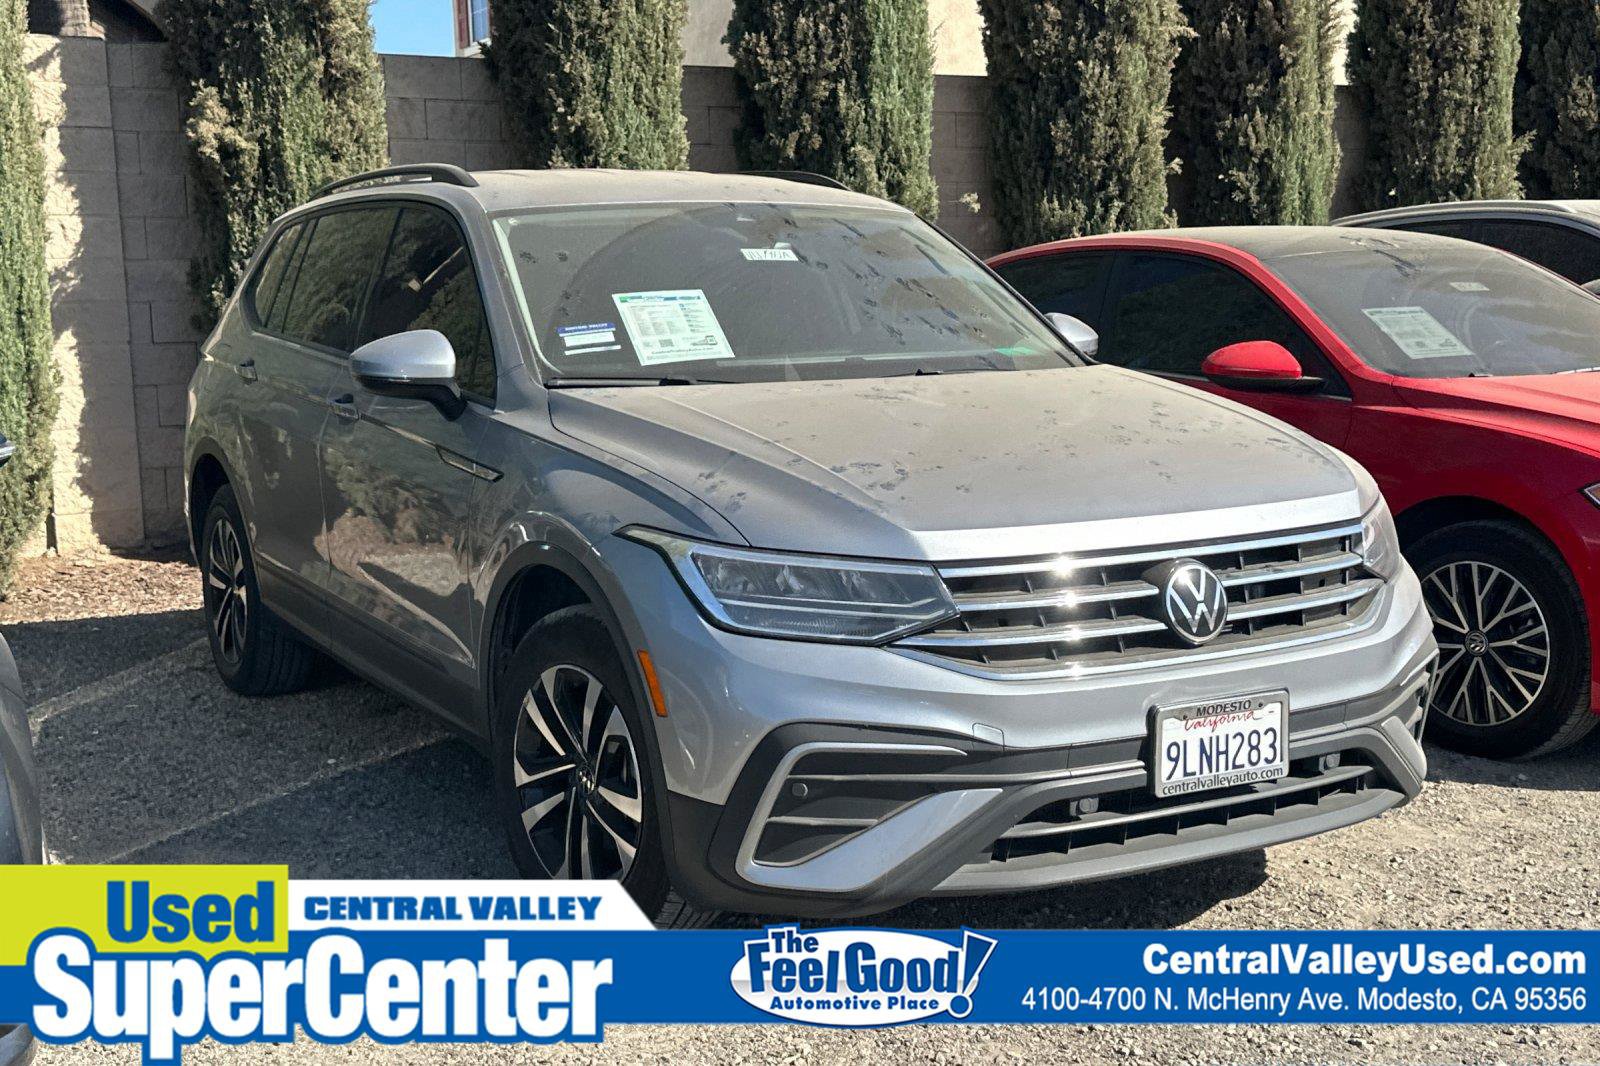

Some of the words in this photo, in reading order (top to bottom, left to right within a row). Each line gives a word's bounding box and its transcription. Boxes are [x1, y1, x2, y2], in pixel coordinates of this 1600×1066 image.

[1196, 699, 1251, 716] MODESTO
[1166, 727, 1277, 780] 9LNH283
[1162, 766, 1283, 796] centralvalleyauto.com
